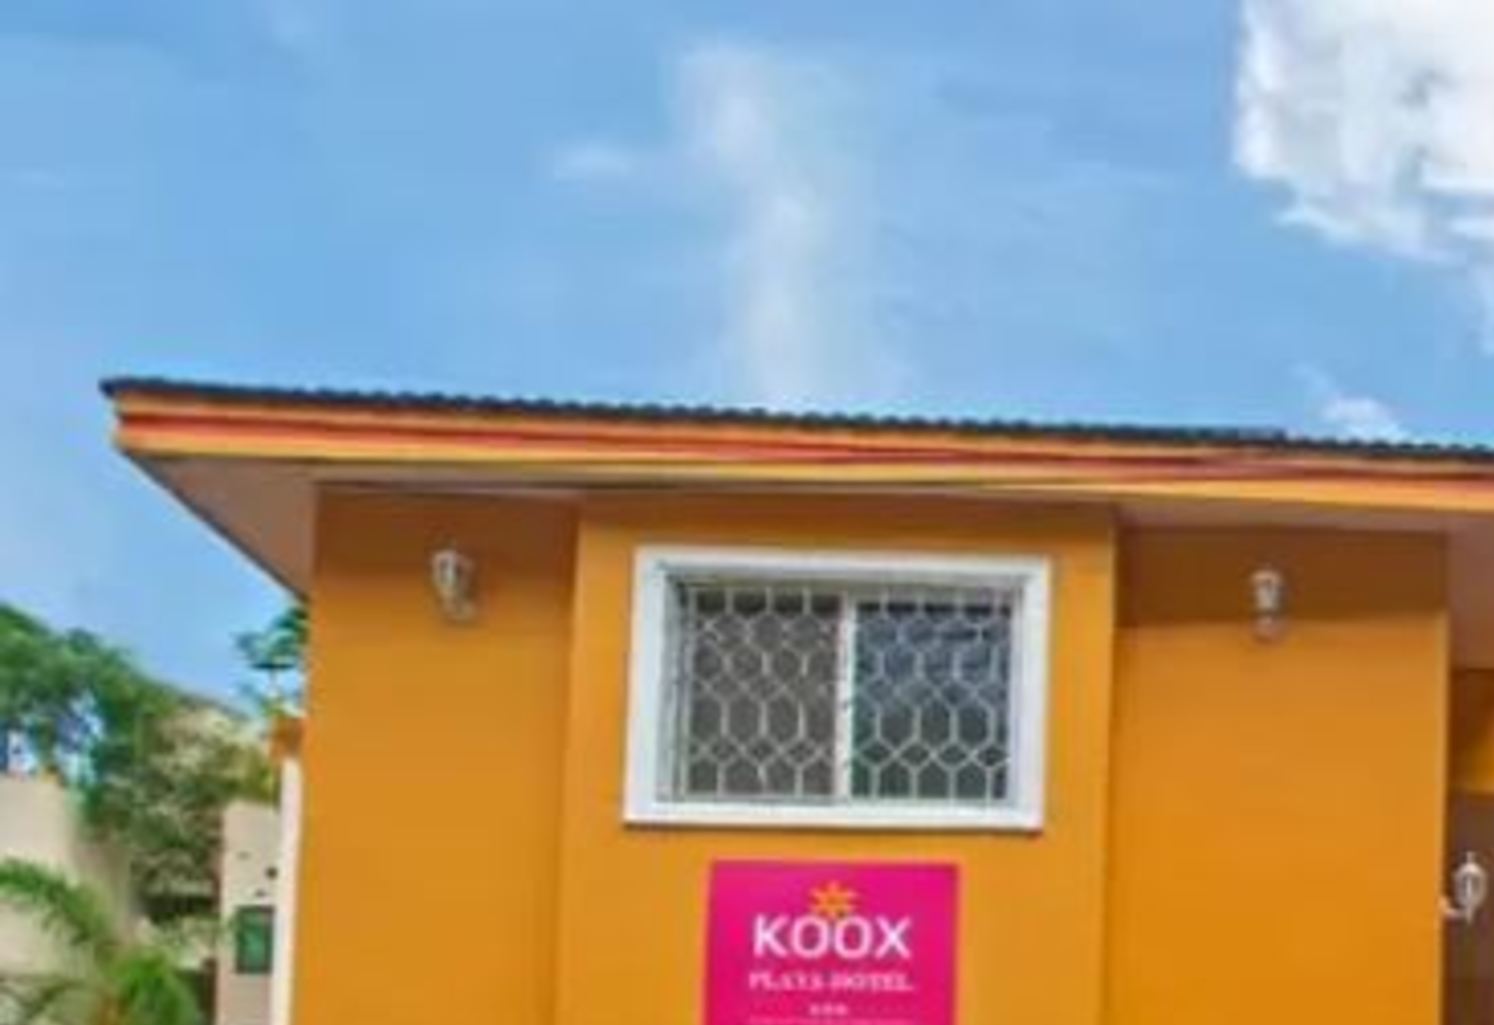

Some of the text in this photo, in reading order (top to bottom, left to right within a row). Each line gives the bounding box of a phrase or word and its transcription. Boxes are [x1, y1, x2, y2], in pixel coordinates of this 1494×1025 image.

[753, 914, 912, 959] KOOX
[749, 972, 914, 991] PLAYA HOTEL
